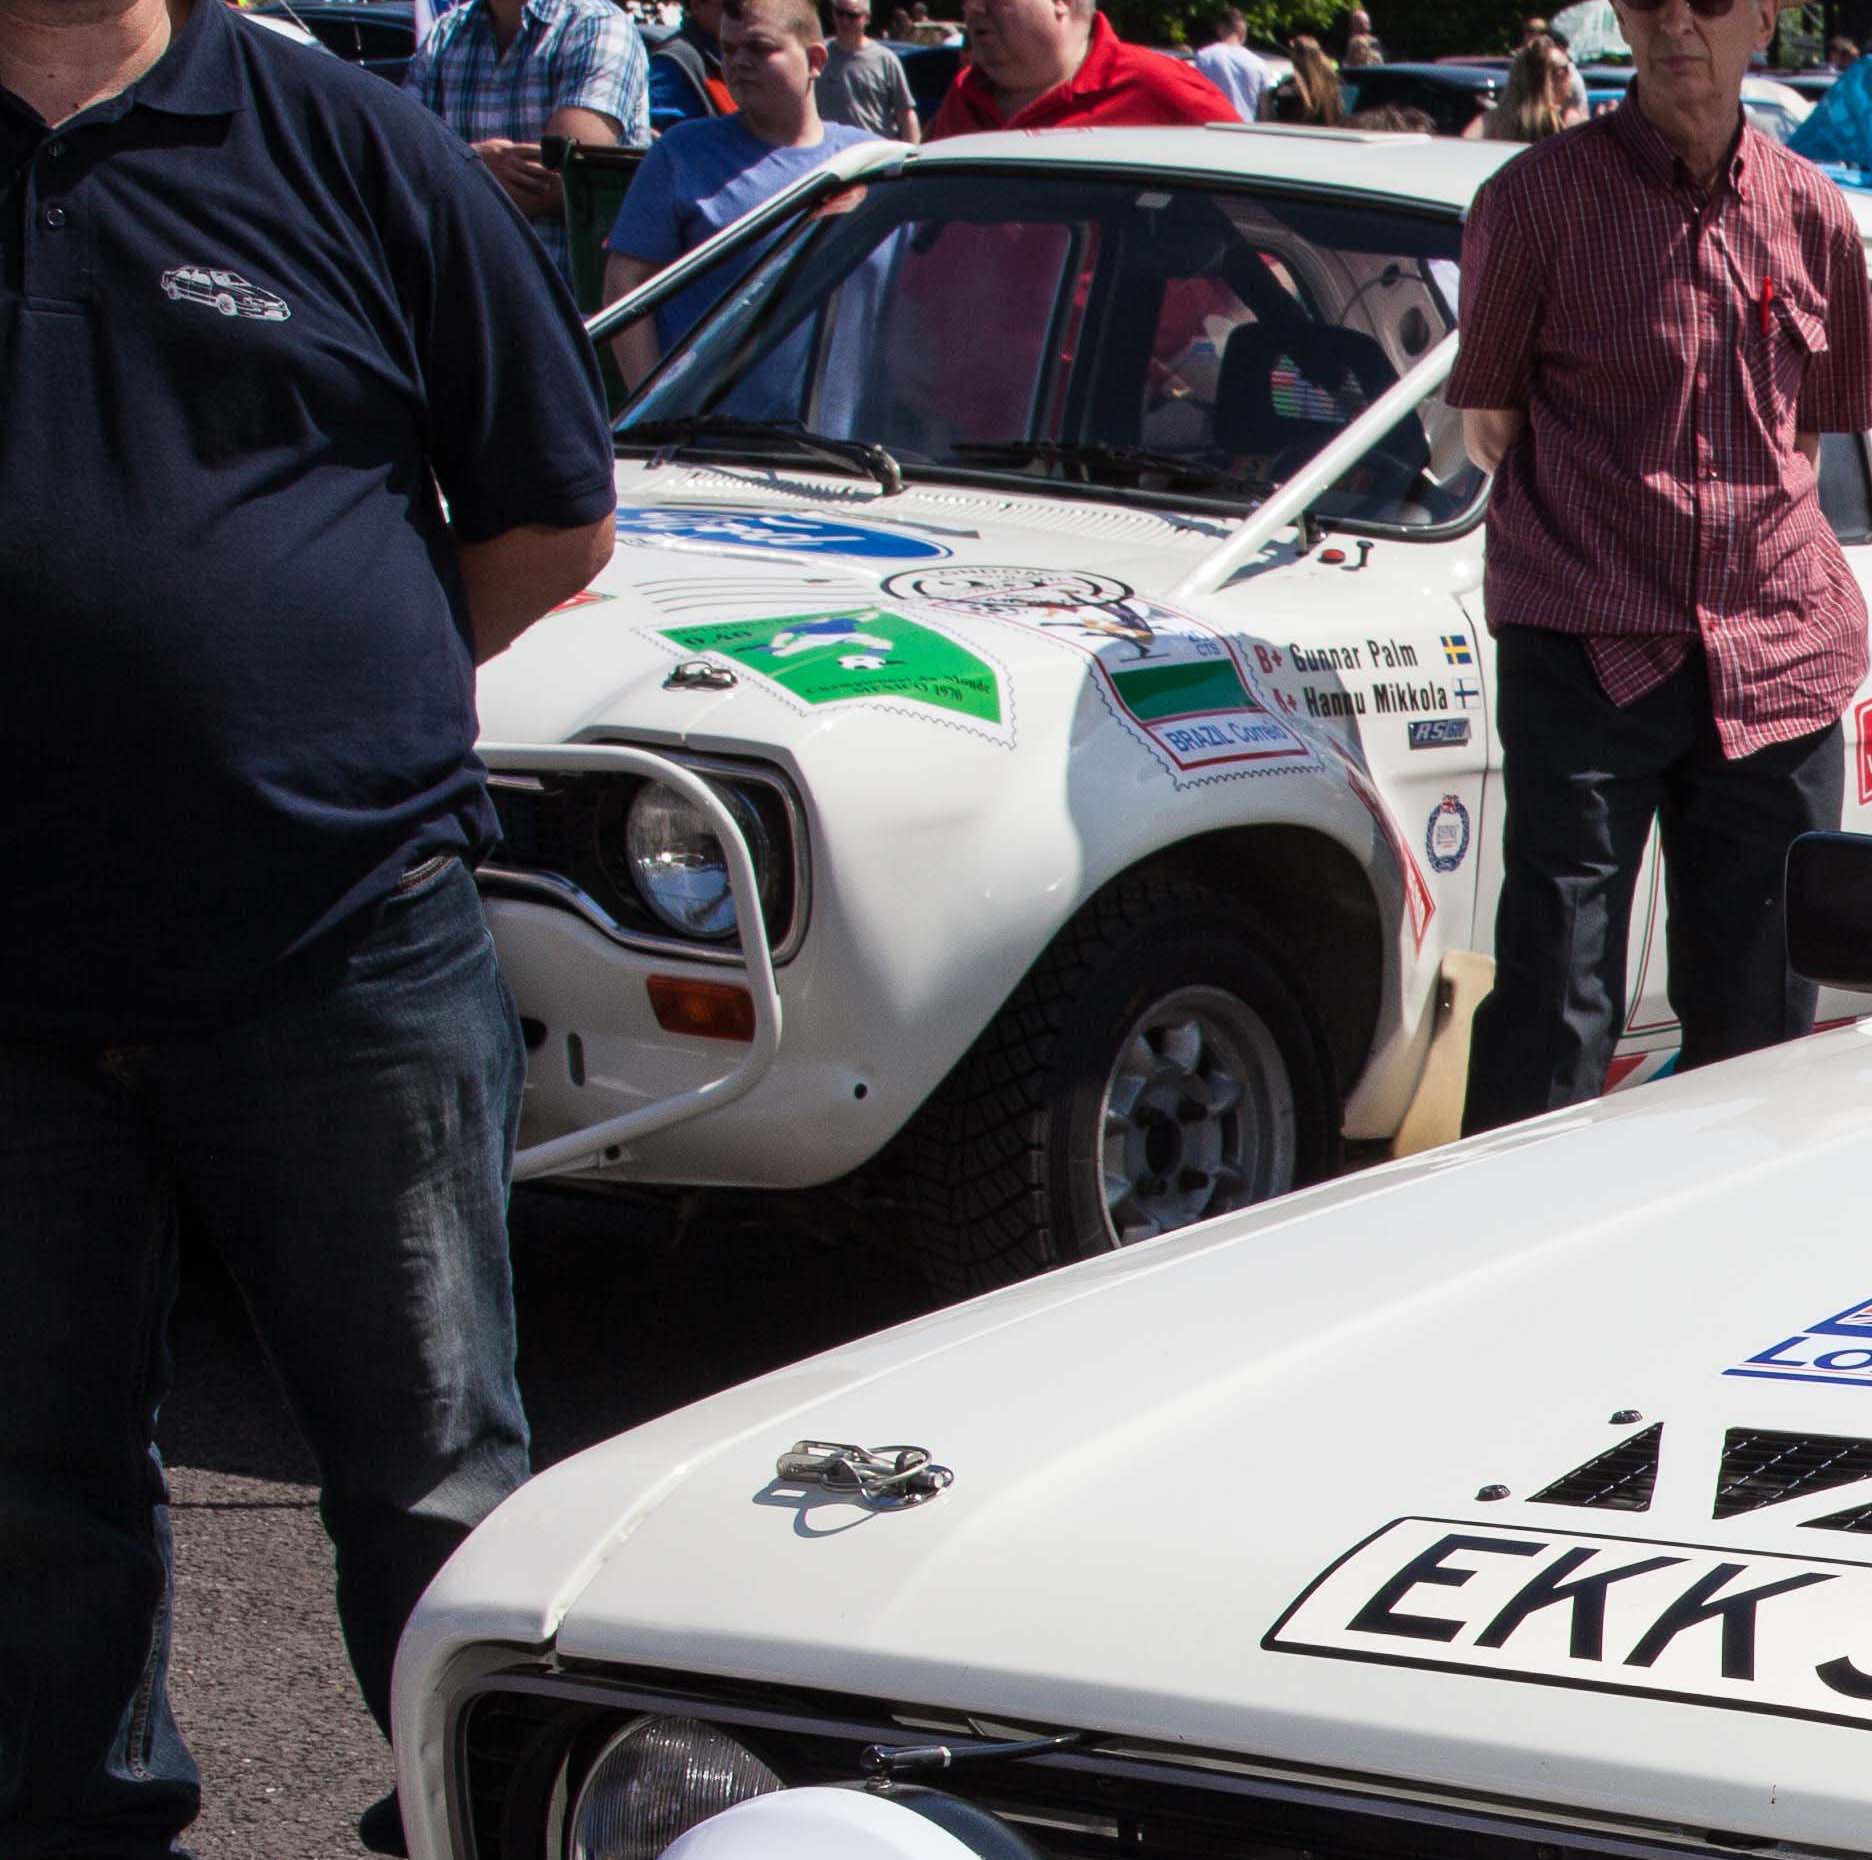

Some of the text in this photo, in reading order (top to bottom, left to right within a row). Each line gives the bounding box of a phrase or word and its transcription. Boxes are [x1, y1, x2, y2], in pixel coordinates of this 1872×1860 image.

[1289, 643, 1363, 672] Gunnar
[1366, 639, 1419, 669] Palm
[1303, 686, 1367, 718] Hannu
[1371, 679, 1449, 715] Mikkola
[1165, 723, 1235, 753] BRAZIL
[1342, 1532, 1839, 1682] EKK
